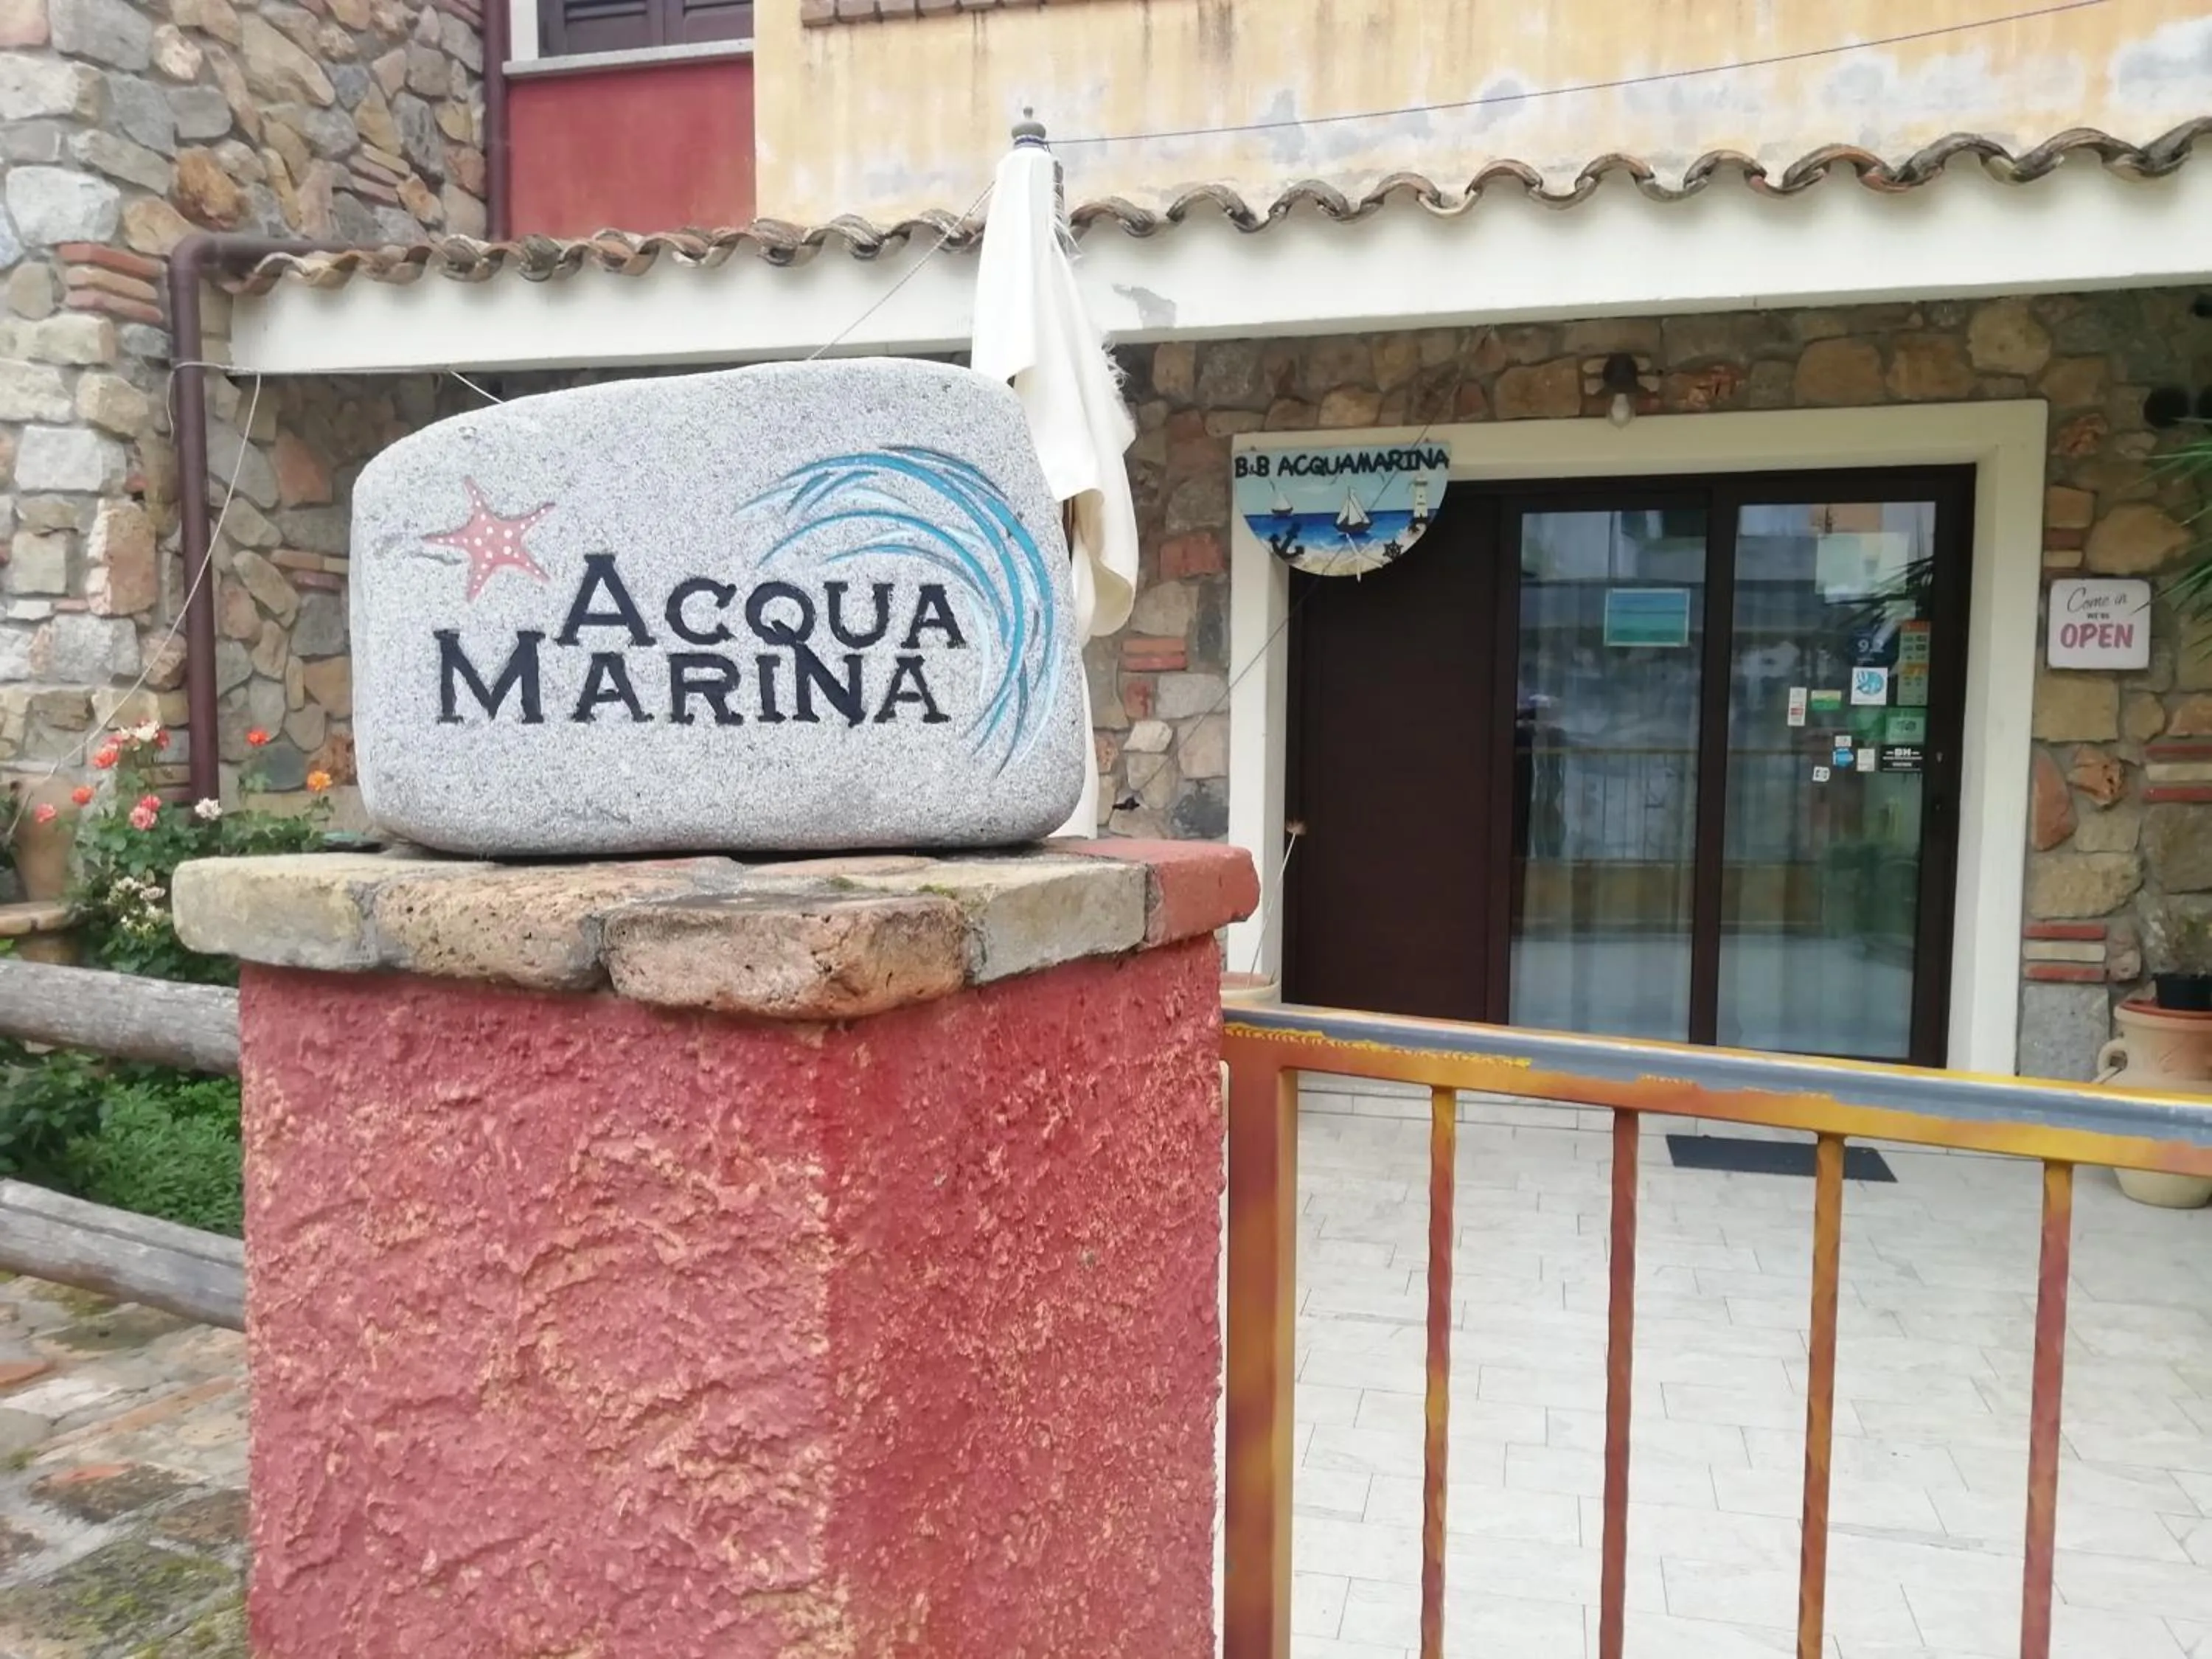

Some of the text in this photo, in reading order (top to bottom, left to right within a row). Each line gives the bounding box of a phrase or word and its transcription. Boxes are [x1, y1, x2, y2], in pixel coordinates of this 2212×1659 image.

[1277, 448, 1450, 476] ACQUAMARINA
[554, 553, 967, 649] ACQUA
[2067, 587, 2127, 613] Come in
[2060, 623, 2134, 649] OPEN
[433, 629, 951, 727] MARINA
